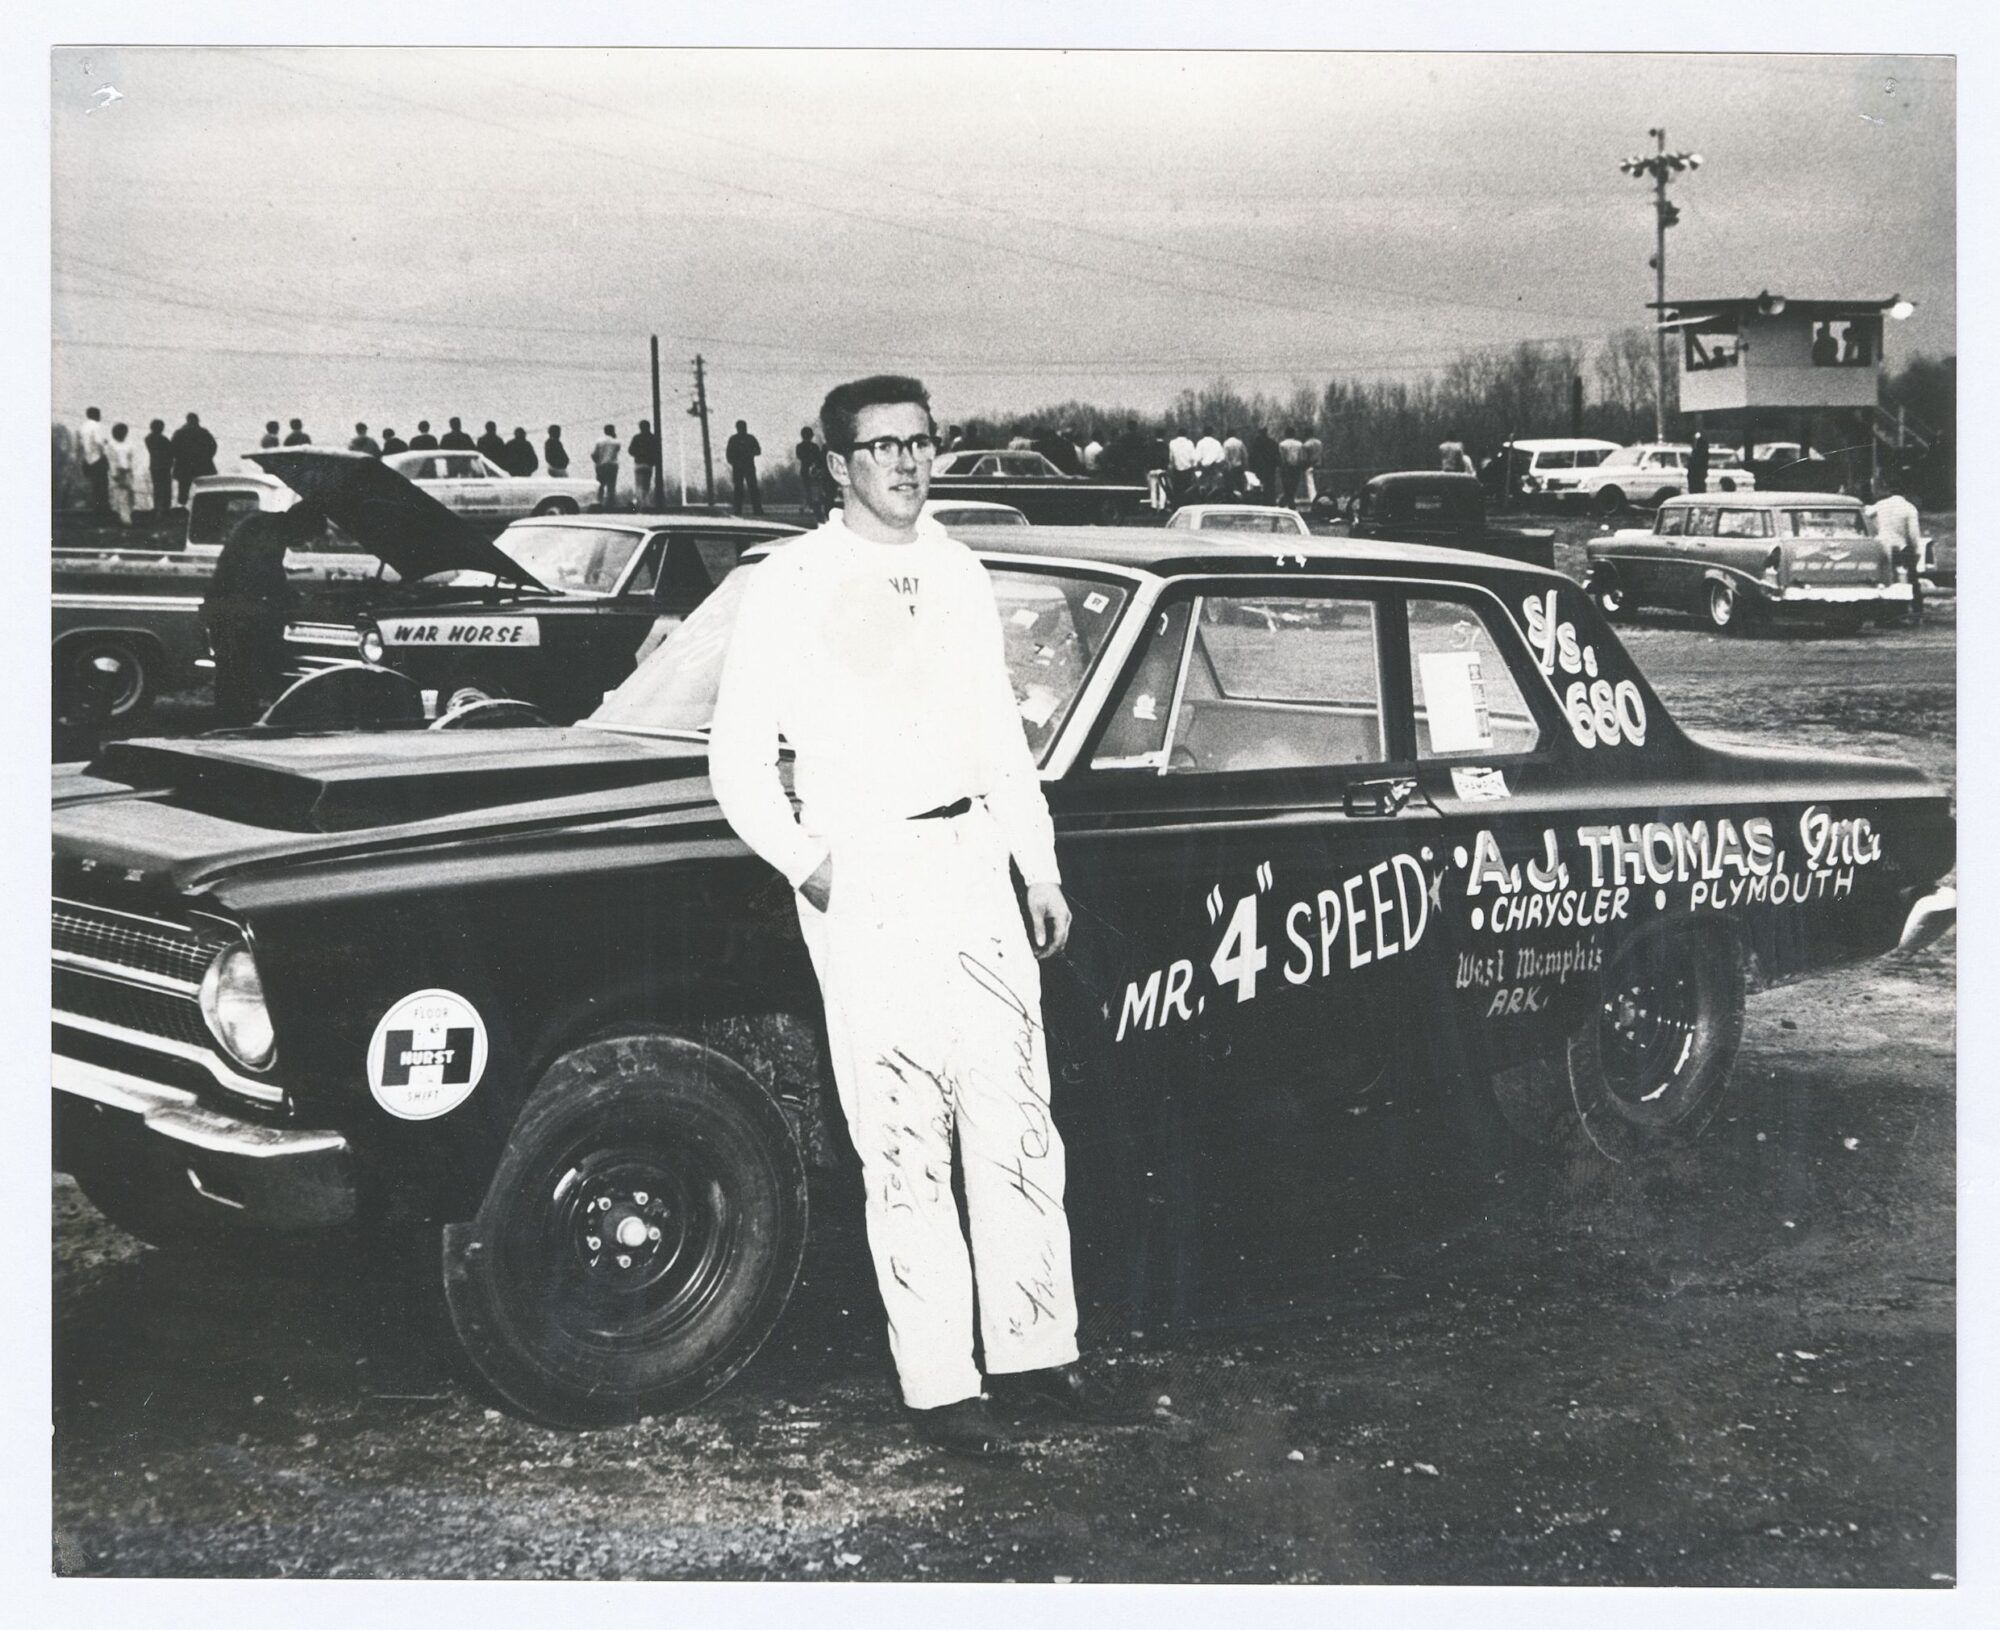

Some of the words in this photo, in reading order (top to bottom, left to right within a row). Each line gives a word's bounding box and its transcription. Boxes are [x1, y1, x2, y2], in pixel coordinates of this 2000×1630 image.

[393, 625, 440, 642] WAR
[447, 625, 524, 643] HORSE
[1565, 678, 1647, 749] 680
[1490, 886, 1630, 933] CHRYSLER
[1689, 866, 1855, 912] PLYMOUTH
[1283, 852, 1430, 986] SPEED
[1455, 948, 1504, 989] West
[1515, 933, 1603, 985] Memphis
[414, 1006, 449, 1019] FLOOR
[399, 1048, 456, 1067] HURST
[407, 1089, 440, 1102] SHIFT
